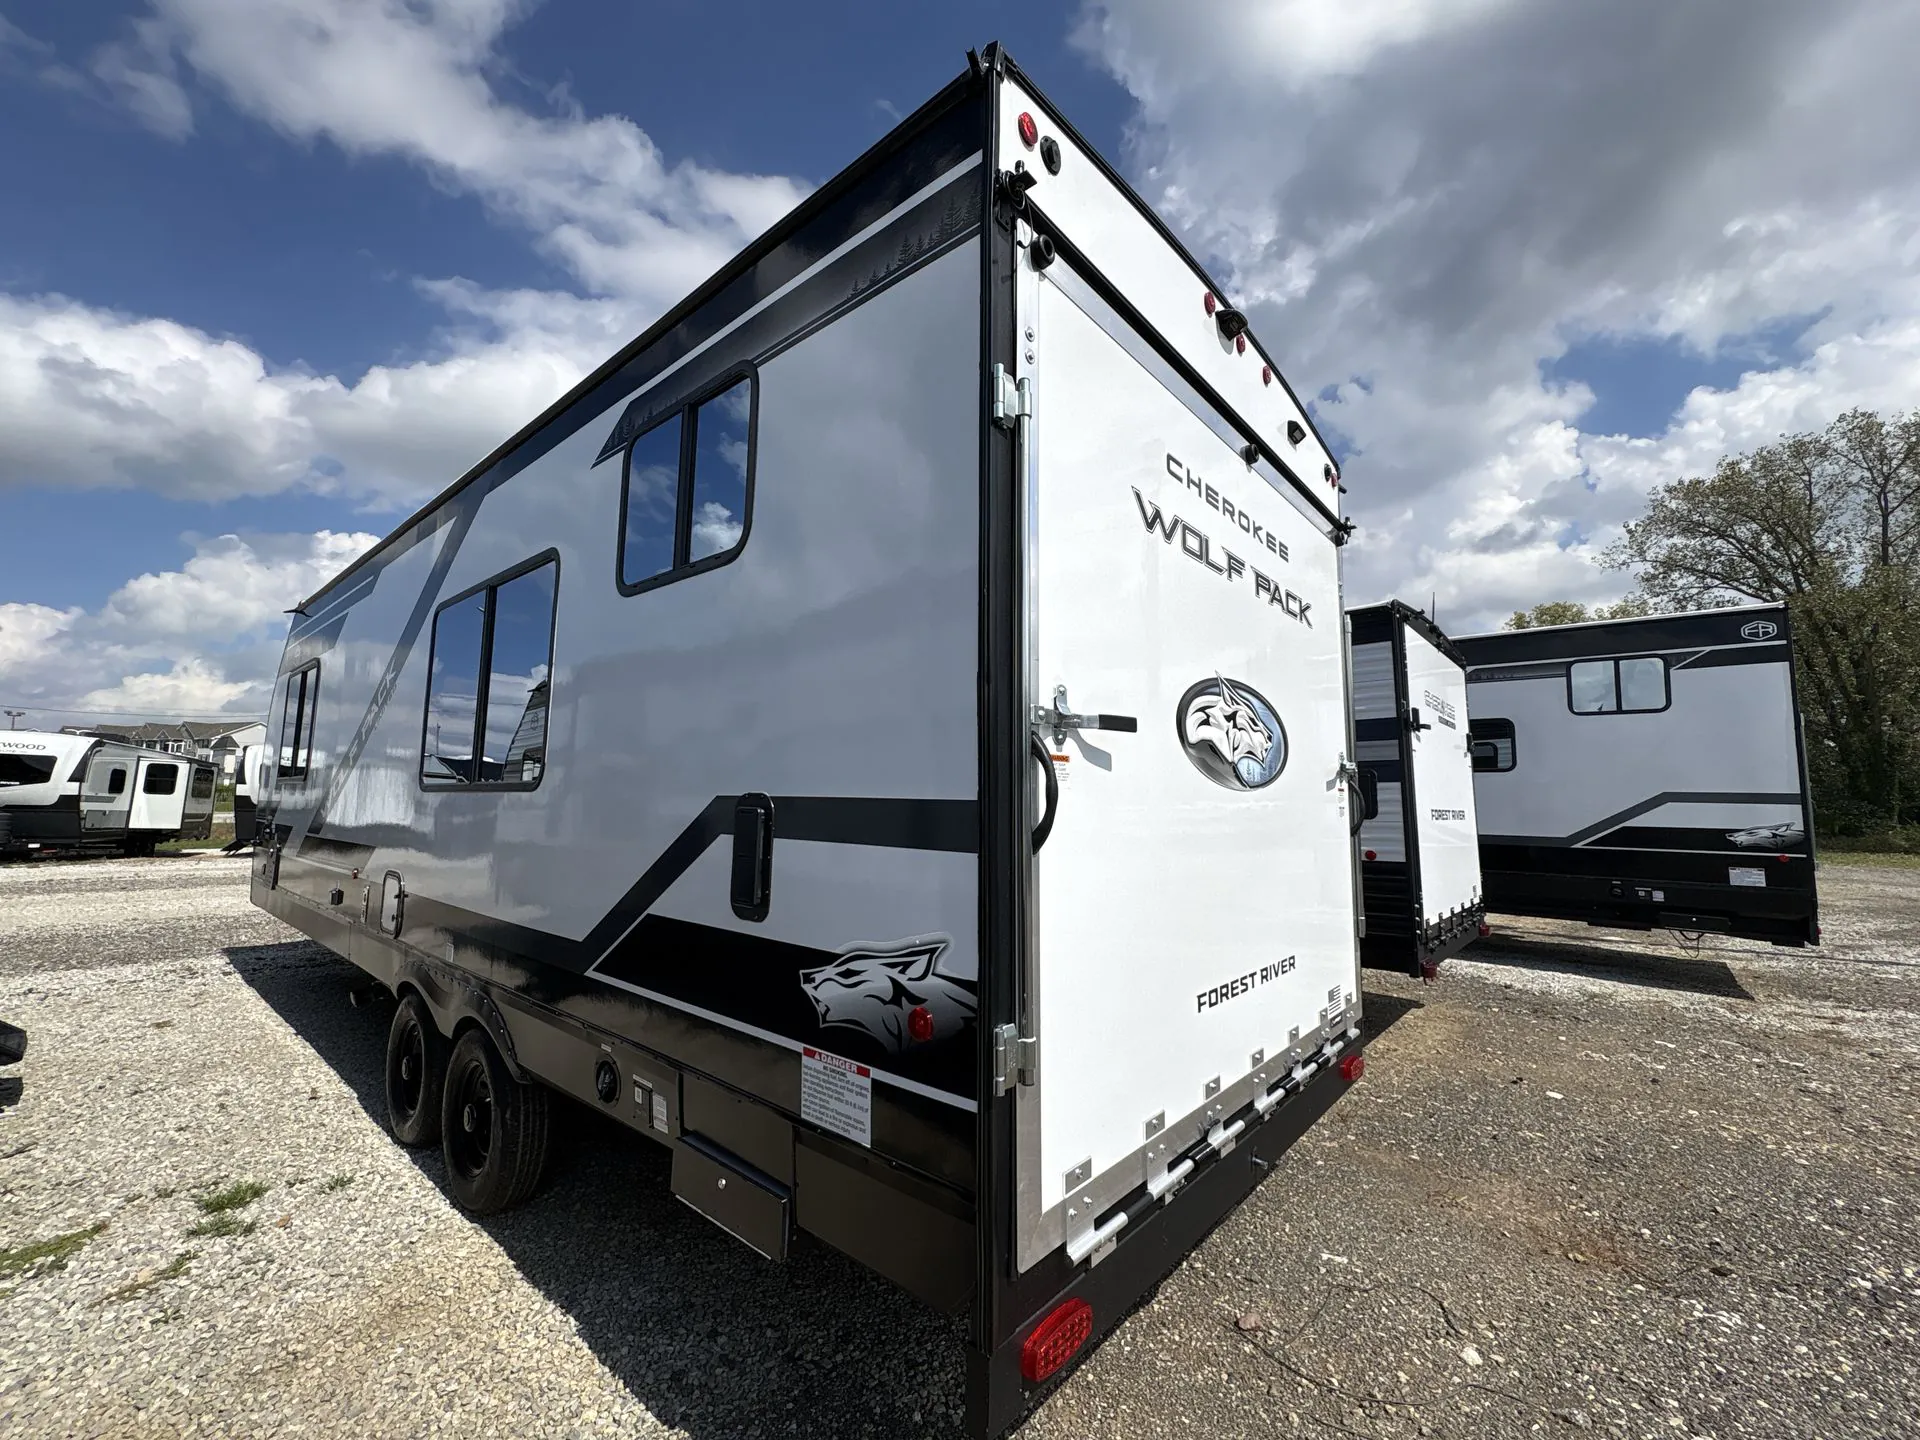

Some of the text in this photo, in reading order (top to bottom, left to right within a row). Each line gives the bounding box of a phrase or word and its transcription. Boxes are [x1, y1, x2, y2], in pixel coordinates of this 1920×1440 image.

[1166, 452, 1290, 563] CHEROKEE
[1131, 485, 1313, 629] WOLF PACK
[0, 742, 46, 750] WOOD
[1196, 955, 1296, 1013] FOREST RIVER
[821, 1053, 858, 1074] DANGER
